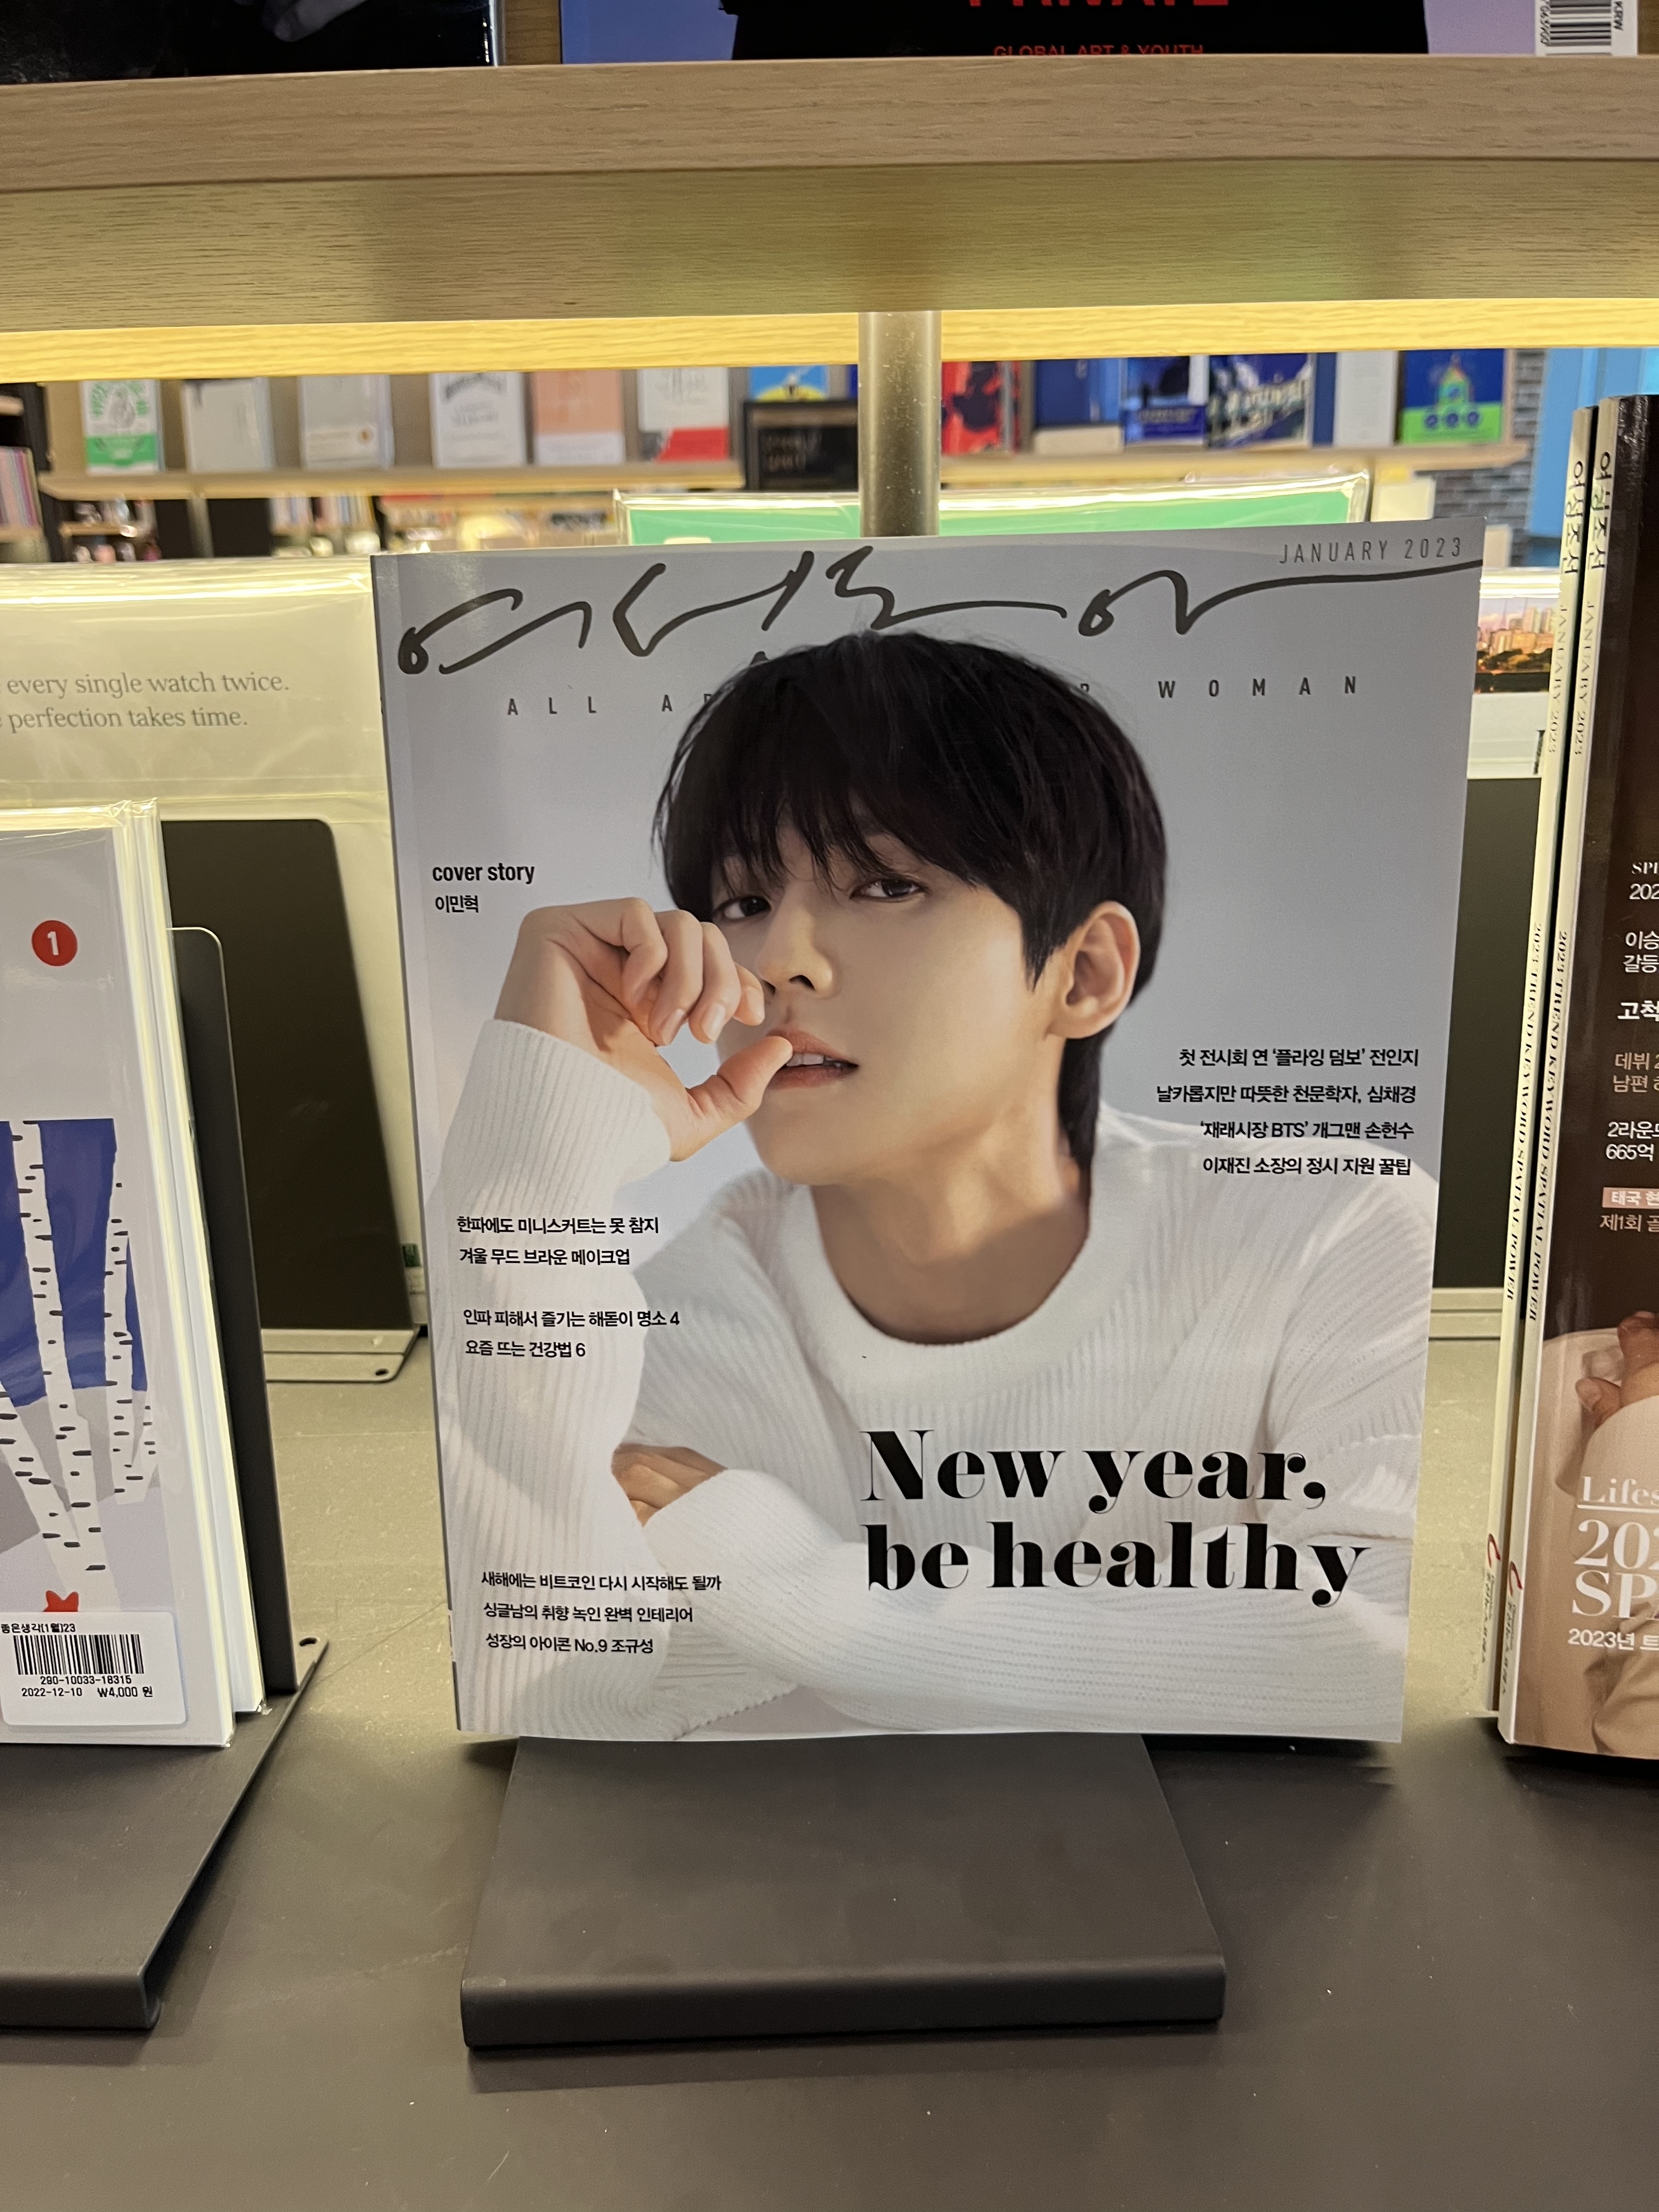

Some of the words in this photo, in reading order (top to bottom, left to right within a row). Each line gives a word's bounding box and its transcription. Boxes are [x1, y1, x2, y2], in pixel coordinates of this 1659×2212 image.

[1279, 540, 1388, 565] JANUARY
[1404, 537, 1462, 560] 2023
[7, 678, 68, 699] every
[75, 672, 143, 699] single
[147, 671, 216, 693] watch
[222, 672, 290, 692] twice.
[1158, 676, 1356, 699] WOMAN
[506, 696, 597, 715] ALL
[8, 707, 122, 734] perfection
[128, 707, 186, 727] takes
[192, 708, 248, 727] time.
[432, 866, 483, 881] cover
[488, 862, 535, 884] story
[435, 895, 479, 913] 이민혁
[47, 932, 59, 956] 1
[1622, 953, 1659, 973] 갈등
[1551, 979, 1564, 1050] TREND
[1179, 1049, 1195, 1066] 첫
[1199, 1049, 1248, 1066] 전시회
[1252, 1048, 1268, 1066] 연
[1369, 1048, 1419, 1066] 전인지
[1615, 1052, 1650, 1070] 데뷔
[1613, 1075, 1649, 1093] 남편
[1157, 1085, 1237, 1103] 날카롭지만
[1240, 1085, 1289, 1103] 따뜻한
[1293, 1085, 1362, 1104] 천문학자,
[1367, 1086, 1416, 1103] 심채경
[1312, 1121, 1361, 1139] 개그맨
[1364, 1122, 1414, 1139] 손헌수
[1605, 1143, 1654, 1162] 665억
[1203, 1157, 1250, 1174] 이재진
[1253, 1157, 1302, 1175] 소장의
[1306, 1158, 1338, 1175] 정시
[1342, 1158, 1375, 1175] 지원
[1379, 1158, 1411, 1176] 꿀팁
[1611, 1191, 1642, 1206] 태국
[456, 1216, 515, 1234] 한파에도
[518, 1217, 606, 1234] 미니스커트는
[609, 1217, 625, 1234] 못
[629, 1217, 658, 1234] 참지
[1600, 1214, 1642, 1232] 제1회
[460, 1248, 488, 1265] 겨울
[490, 1249, 521, 1265] 무드
[523, 1249, 568, 1266] 브라운
[571, 1249, 630, 1266] 메이크업
[463, 1309, 492, 1326] 인파
[494, 1310, 538, 1327] 피해서
[541, 1311, 586, 1328] 즐기는
[589, 1311, 633, 1327] 해돋이
[637, 1310, 667, 1327] 명소
[670, 1311, 680, 1325] 4
[465, 1340, 494, 1356] 요즘
[496, 1341, 526, 1357] 뜨는
[529, 1341, 572, 1358] 건강법
[575, 1342, 586, 1357] 6
[860, 1429, 1066, 1501] New
[1082, 1449, 1327, 1514] year,
[860, 1523, 970, 1591] be
[986, 1520, 1372, 1608] healthy
[481, 1571, 537, 1588] 새해에는
[540, 1574, 595, 1590] 비트코인
[599, 1576, 627, 1591] 다시
[631, 1576, 689, 1591] 시작해도
[692, 1575, 721, 1590] 될까
[1571, 1570, 1659, 1620] SP
[483, 1602, 538, 1620] 싱글남의
[541, 1605, 569, 1621] 취향
[572, 1606, 601, 1622] 녹인
[604, 1607, 633, 1622] 완벽
[637, 1607, 693, 1622] 인테리어
[486, 1633, 526, 1650] 성장의
[529, 1636, 571, 1652] 아이콘
[574, 1639, 607, 1653] No.9
[611, 1639, 653, 1654] 조규성
[1567, 1628, 1635, 1651] 2023년
[21, 1688, 83, 1697] 2022-12-10
[142, 1685, 154, 1697] 원
